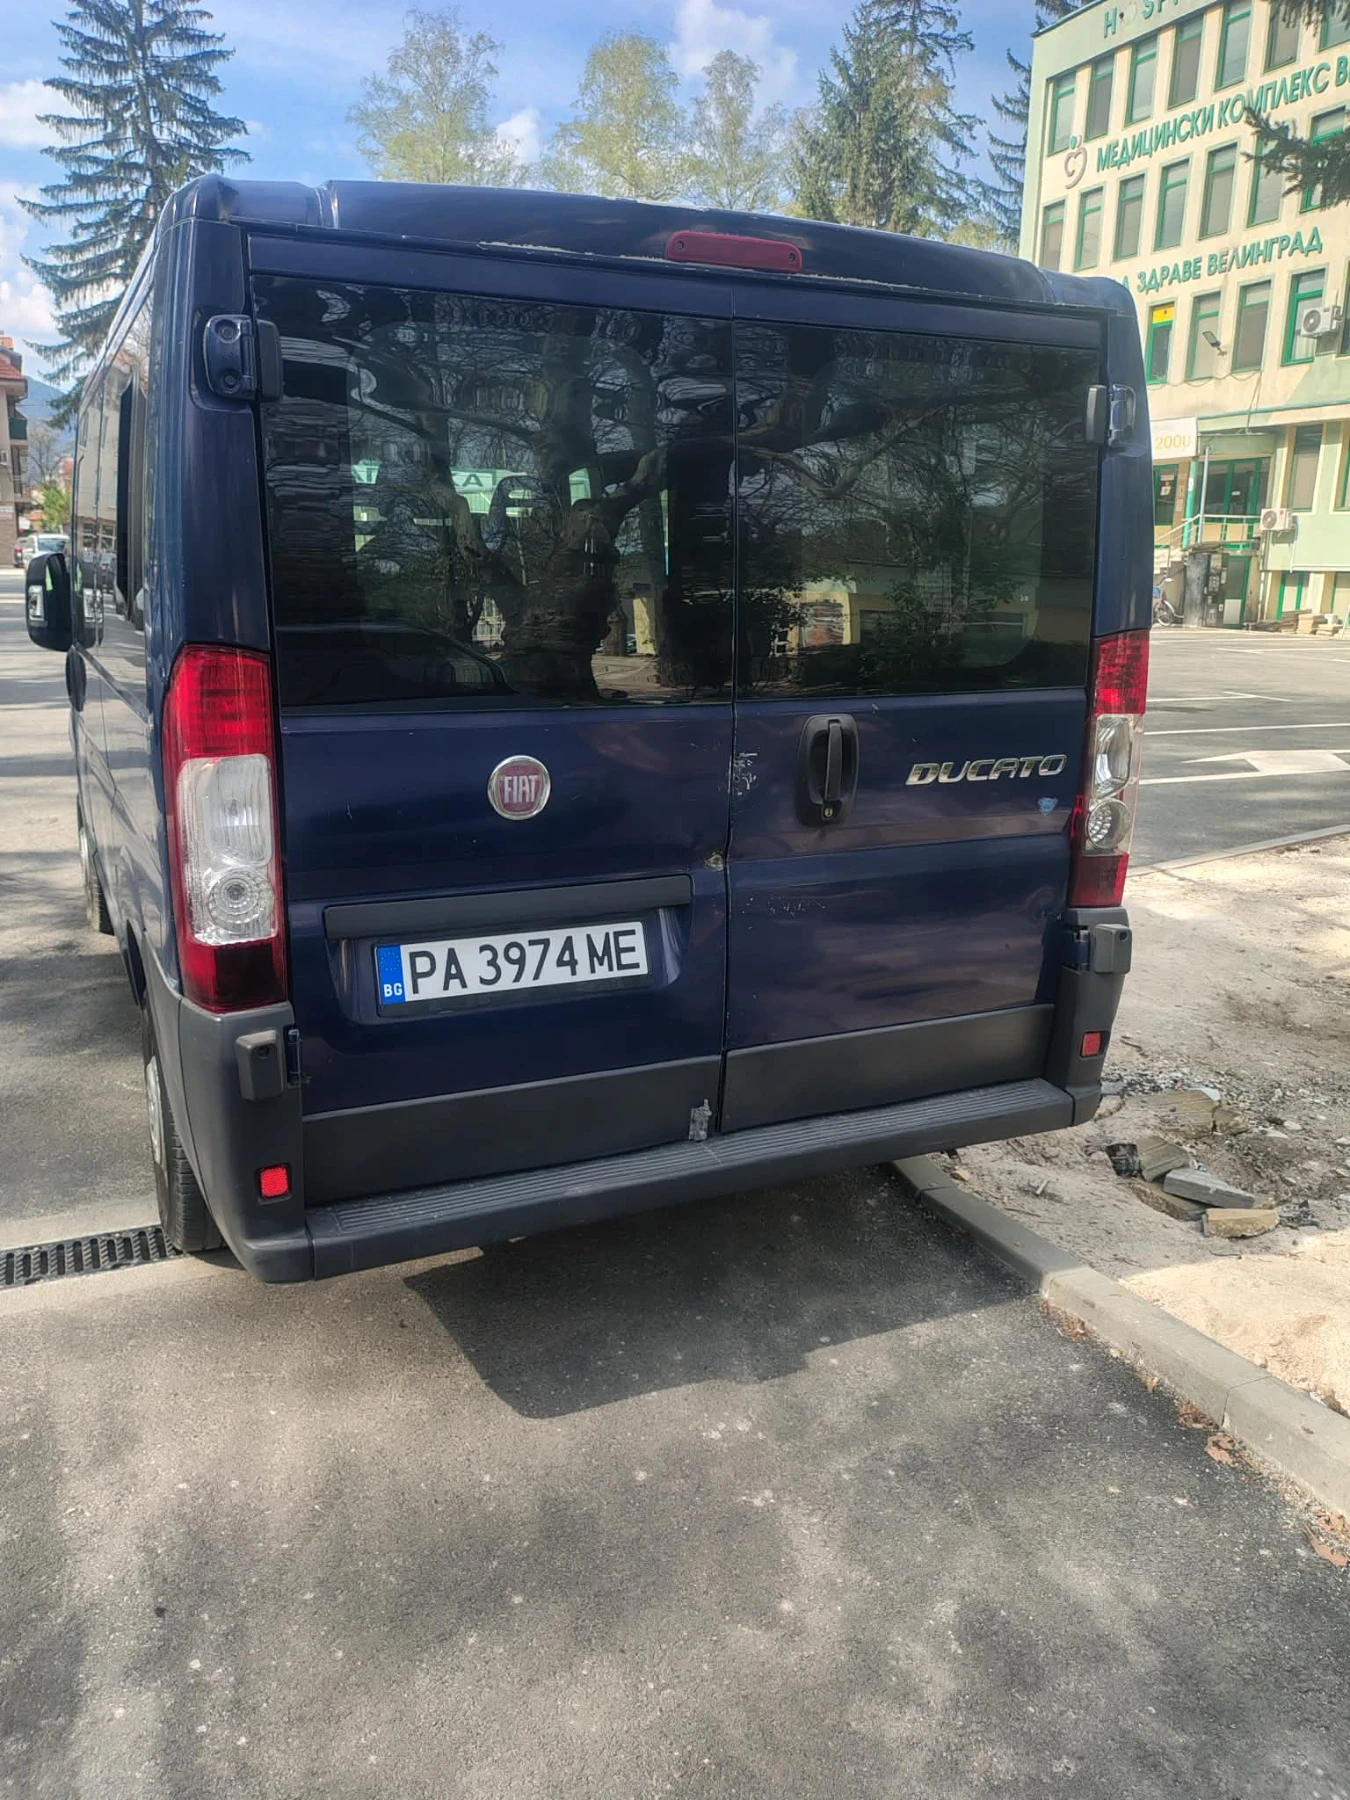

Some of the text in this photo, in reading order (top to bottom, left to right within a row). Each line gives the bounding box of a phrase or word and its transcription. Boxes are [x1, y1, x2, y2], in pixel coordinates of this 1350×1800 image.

[1096, 103, 1215, 173] МЕДИЦИНСКИ
[1217, 62, 1331, 129] КОМПЛЕКС
[1137, 226, 1323, 294] ЗДРАВЕ ВЕЛИНГРАД
[905, 754, 1068, 785] DUCATO
[503, 774, 539, 803] FIAT
[383, 982, 403, 998] BG
